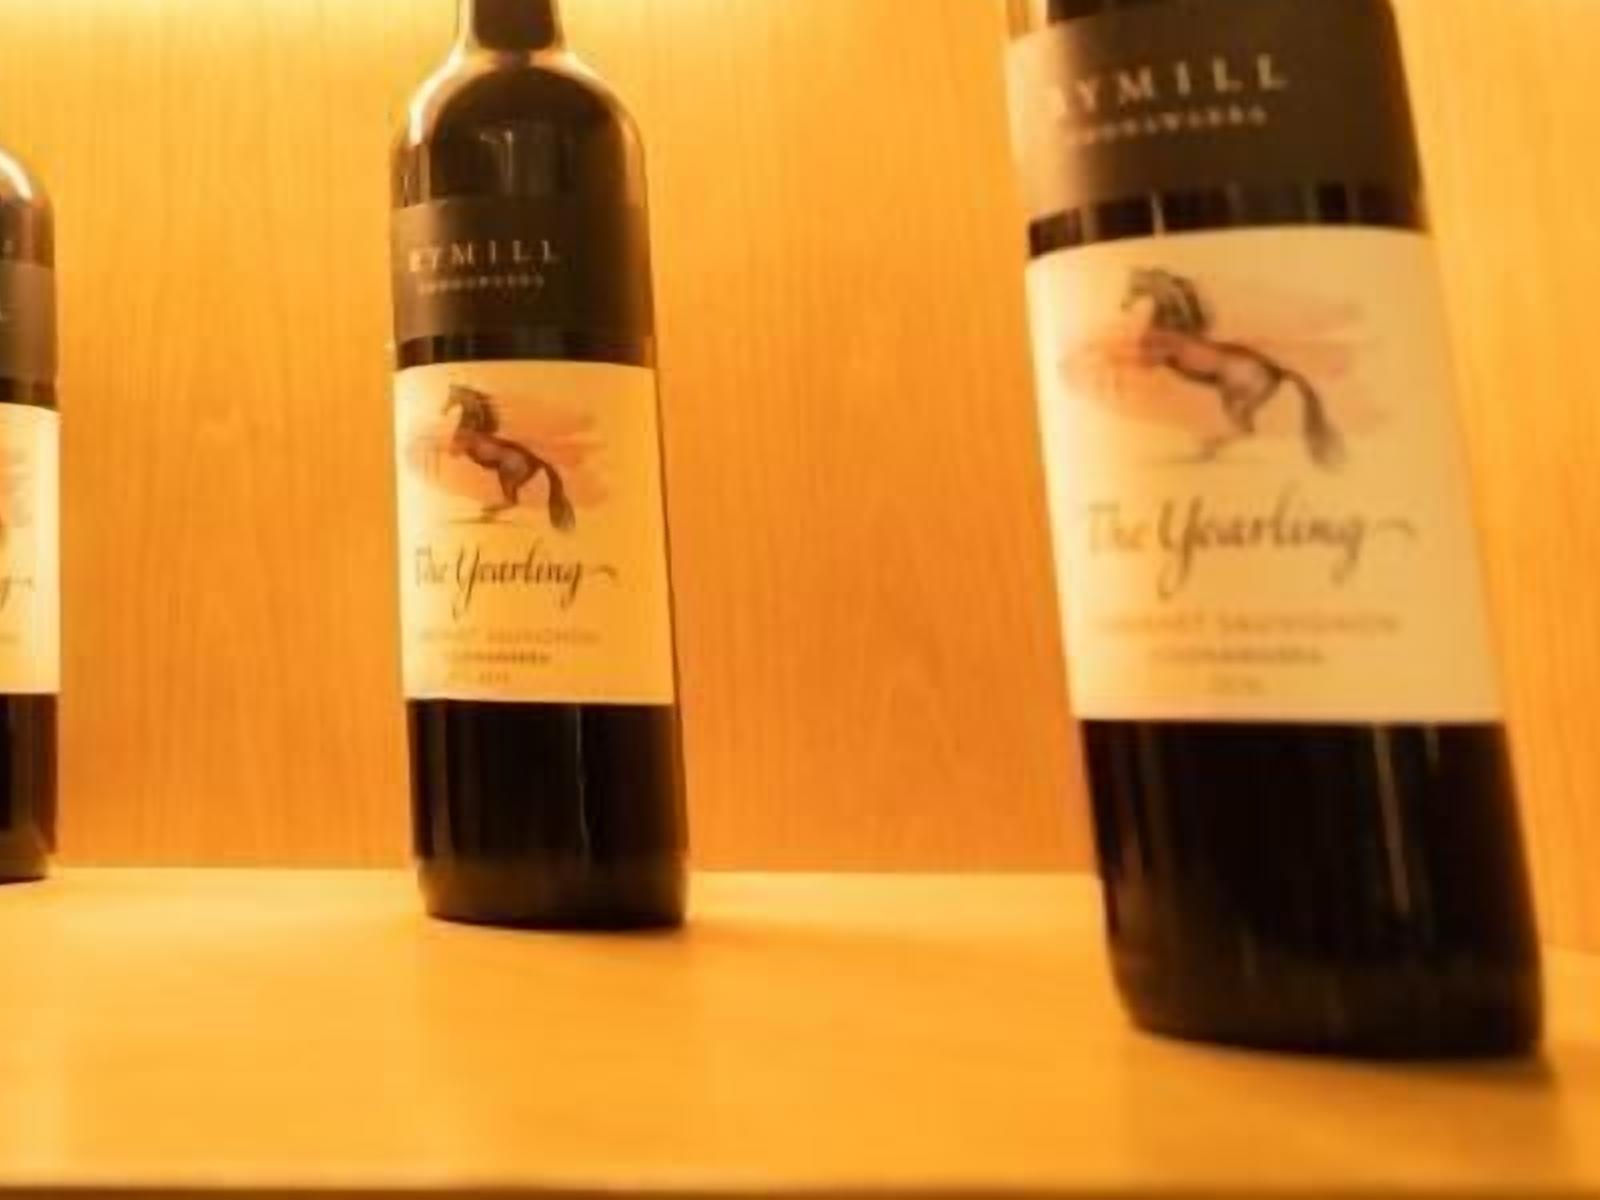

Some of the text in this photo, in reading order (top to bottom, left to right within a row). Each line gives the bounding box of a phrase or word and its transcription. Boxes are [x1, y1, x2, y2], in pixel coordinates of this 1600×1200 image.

[451, 538, 619, 623] Yearling
[1087, 482, 1418, 601] The Yearling
